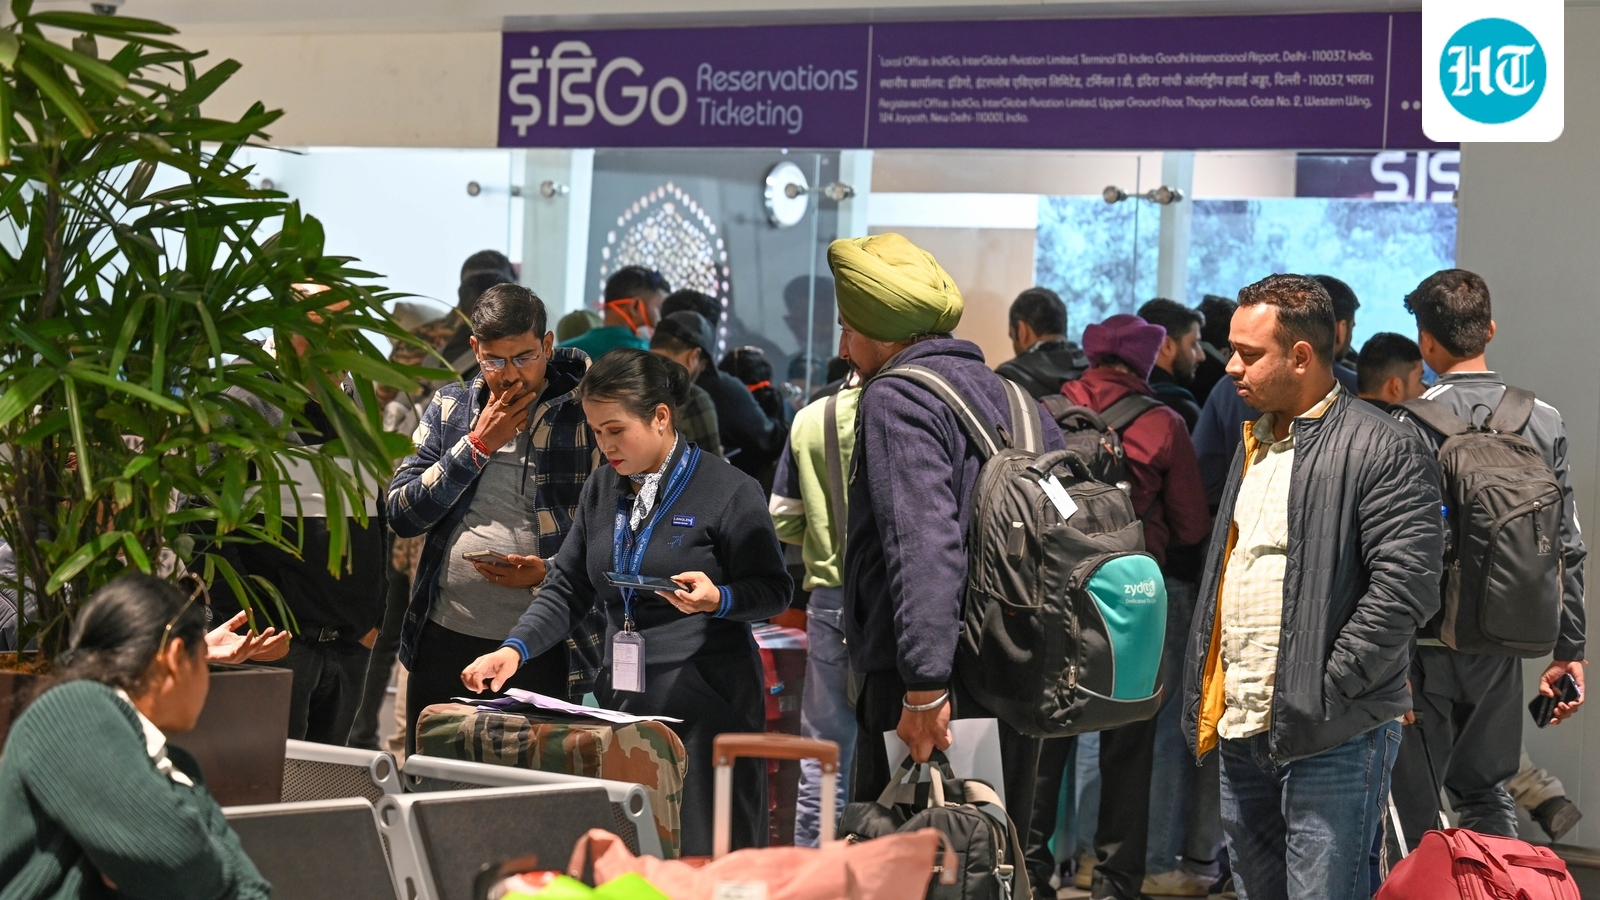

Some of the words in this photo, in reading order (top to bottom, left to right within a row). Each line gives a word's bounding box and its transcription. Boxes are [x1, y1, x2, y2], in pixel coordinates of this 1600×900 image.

[879, 56, 901, 67] Local
[932, 55, 961, 66] IndiGo,
[962, 55, 1008, 66] InterGlobe
[1009, 55, 1046, 65] Aviation
[1046, 55, 1080, 65] Limited,
[1080, 54, 1116, 64] Terminal
[1129, 54, 1154, 64] Indira
[1155, 52, 1188, 64] Gandhi
[1190, 52, 1247, 63] International
[1248, 51, 1282, 64] Airport,
[1282, 51, 1307, 62] Delhi
[1312, 50, 1346, 62] 110037,
[1348, 50, 1374, 61] India.
[696, 62, 859, 93] Reservations
[879, 76, 908, 88] स्थानीय
[1048, 74, 1084, 88] लिमिटेड,
[1136, 73, 1160, 88] इंदिरा
[1161, 73, 1182, 86] गांधी
[1225, 73, 1248, 87] हवाई
[1274, 73, 1301, 86] दिल्ली
[1308, 74, 1344, 86] 110037,
[1346, 73, 1374, 86] भारत।
[878, 98, 923, 111] Registered
[951, 98, 981, 108] IndiGo,
[982, 97, 1028, 108] InterGlobe
[1029, 97, 1064, 108] Aviation
[1065, 98, 1098, 108] Limited,
[1098, 97, 1126, 109] Upper
[1126, 96, 1161, 108] Ground
[1161, 96, 1185, 108] Floor,
[1218, 97, 1249, 107] House,
[1250, 95, 1274, 107] Gate
[1304, 96, 1344, 106] Western
[1345, 96, 1373, 109] Wing,
[697, 97, 803, 135] Ticketing
[894, 112, 928, 124] Janpath,
[950, 112, 972, 122] Delhi
[1005, 111, 1029, 122] India.
[1124, 580, 1155, 597] zydus
